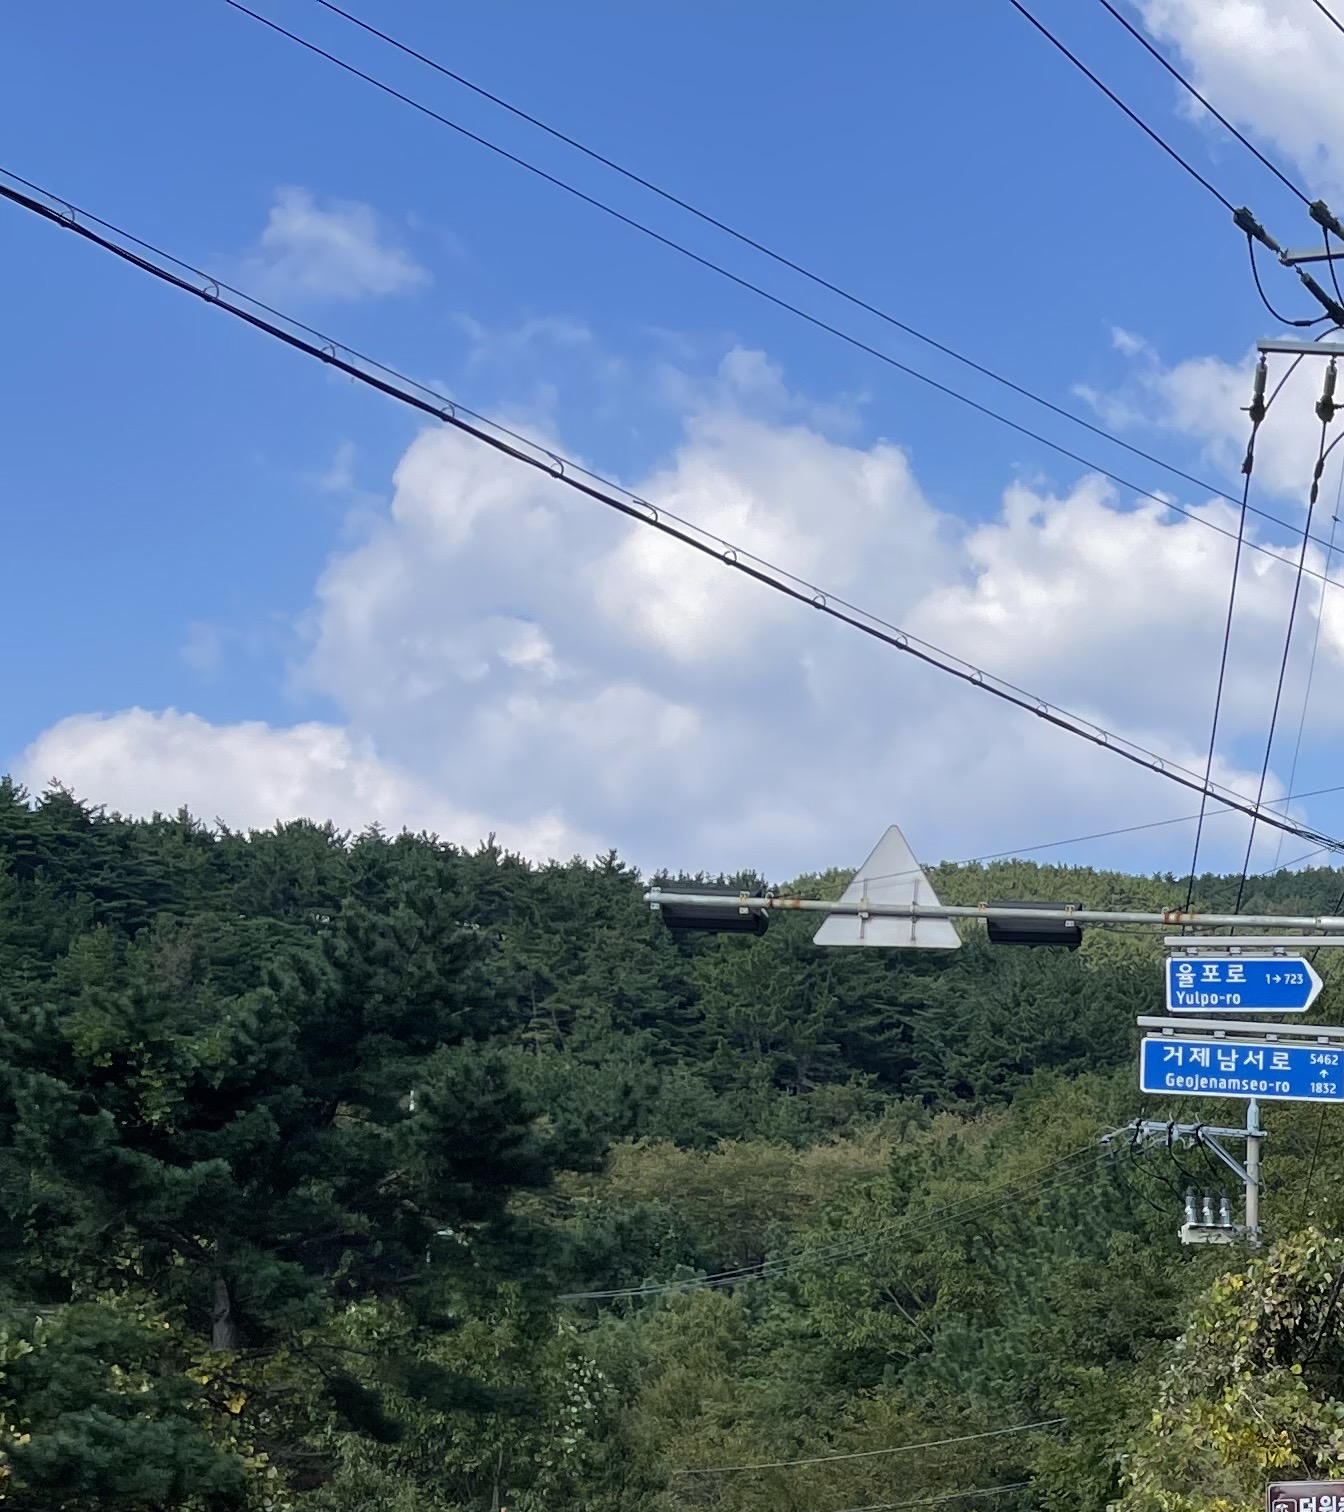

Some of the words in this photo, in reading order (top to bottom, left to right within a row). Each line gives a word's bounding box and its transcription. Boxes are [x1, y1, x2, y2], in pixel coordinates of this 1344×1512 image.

[1175, 963, 1247, 988] 율포로
[1283, 973, 1304, 985] 723
[1175, 990, 1241, 1007] Yulpo-ro
[1163, 1045, 1292, 1072] 거제남서로
[1309, 1053, 1339, 1066] 5462
[1165, 1072, 1290, 1093] Geojenamseo-ro
[1310, 1082, 1337, 1095] 1832
